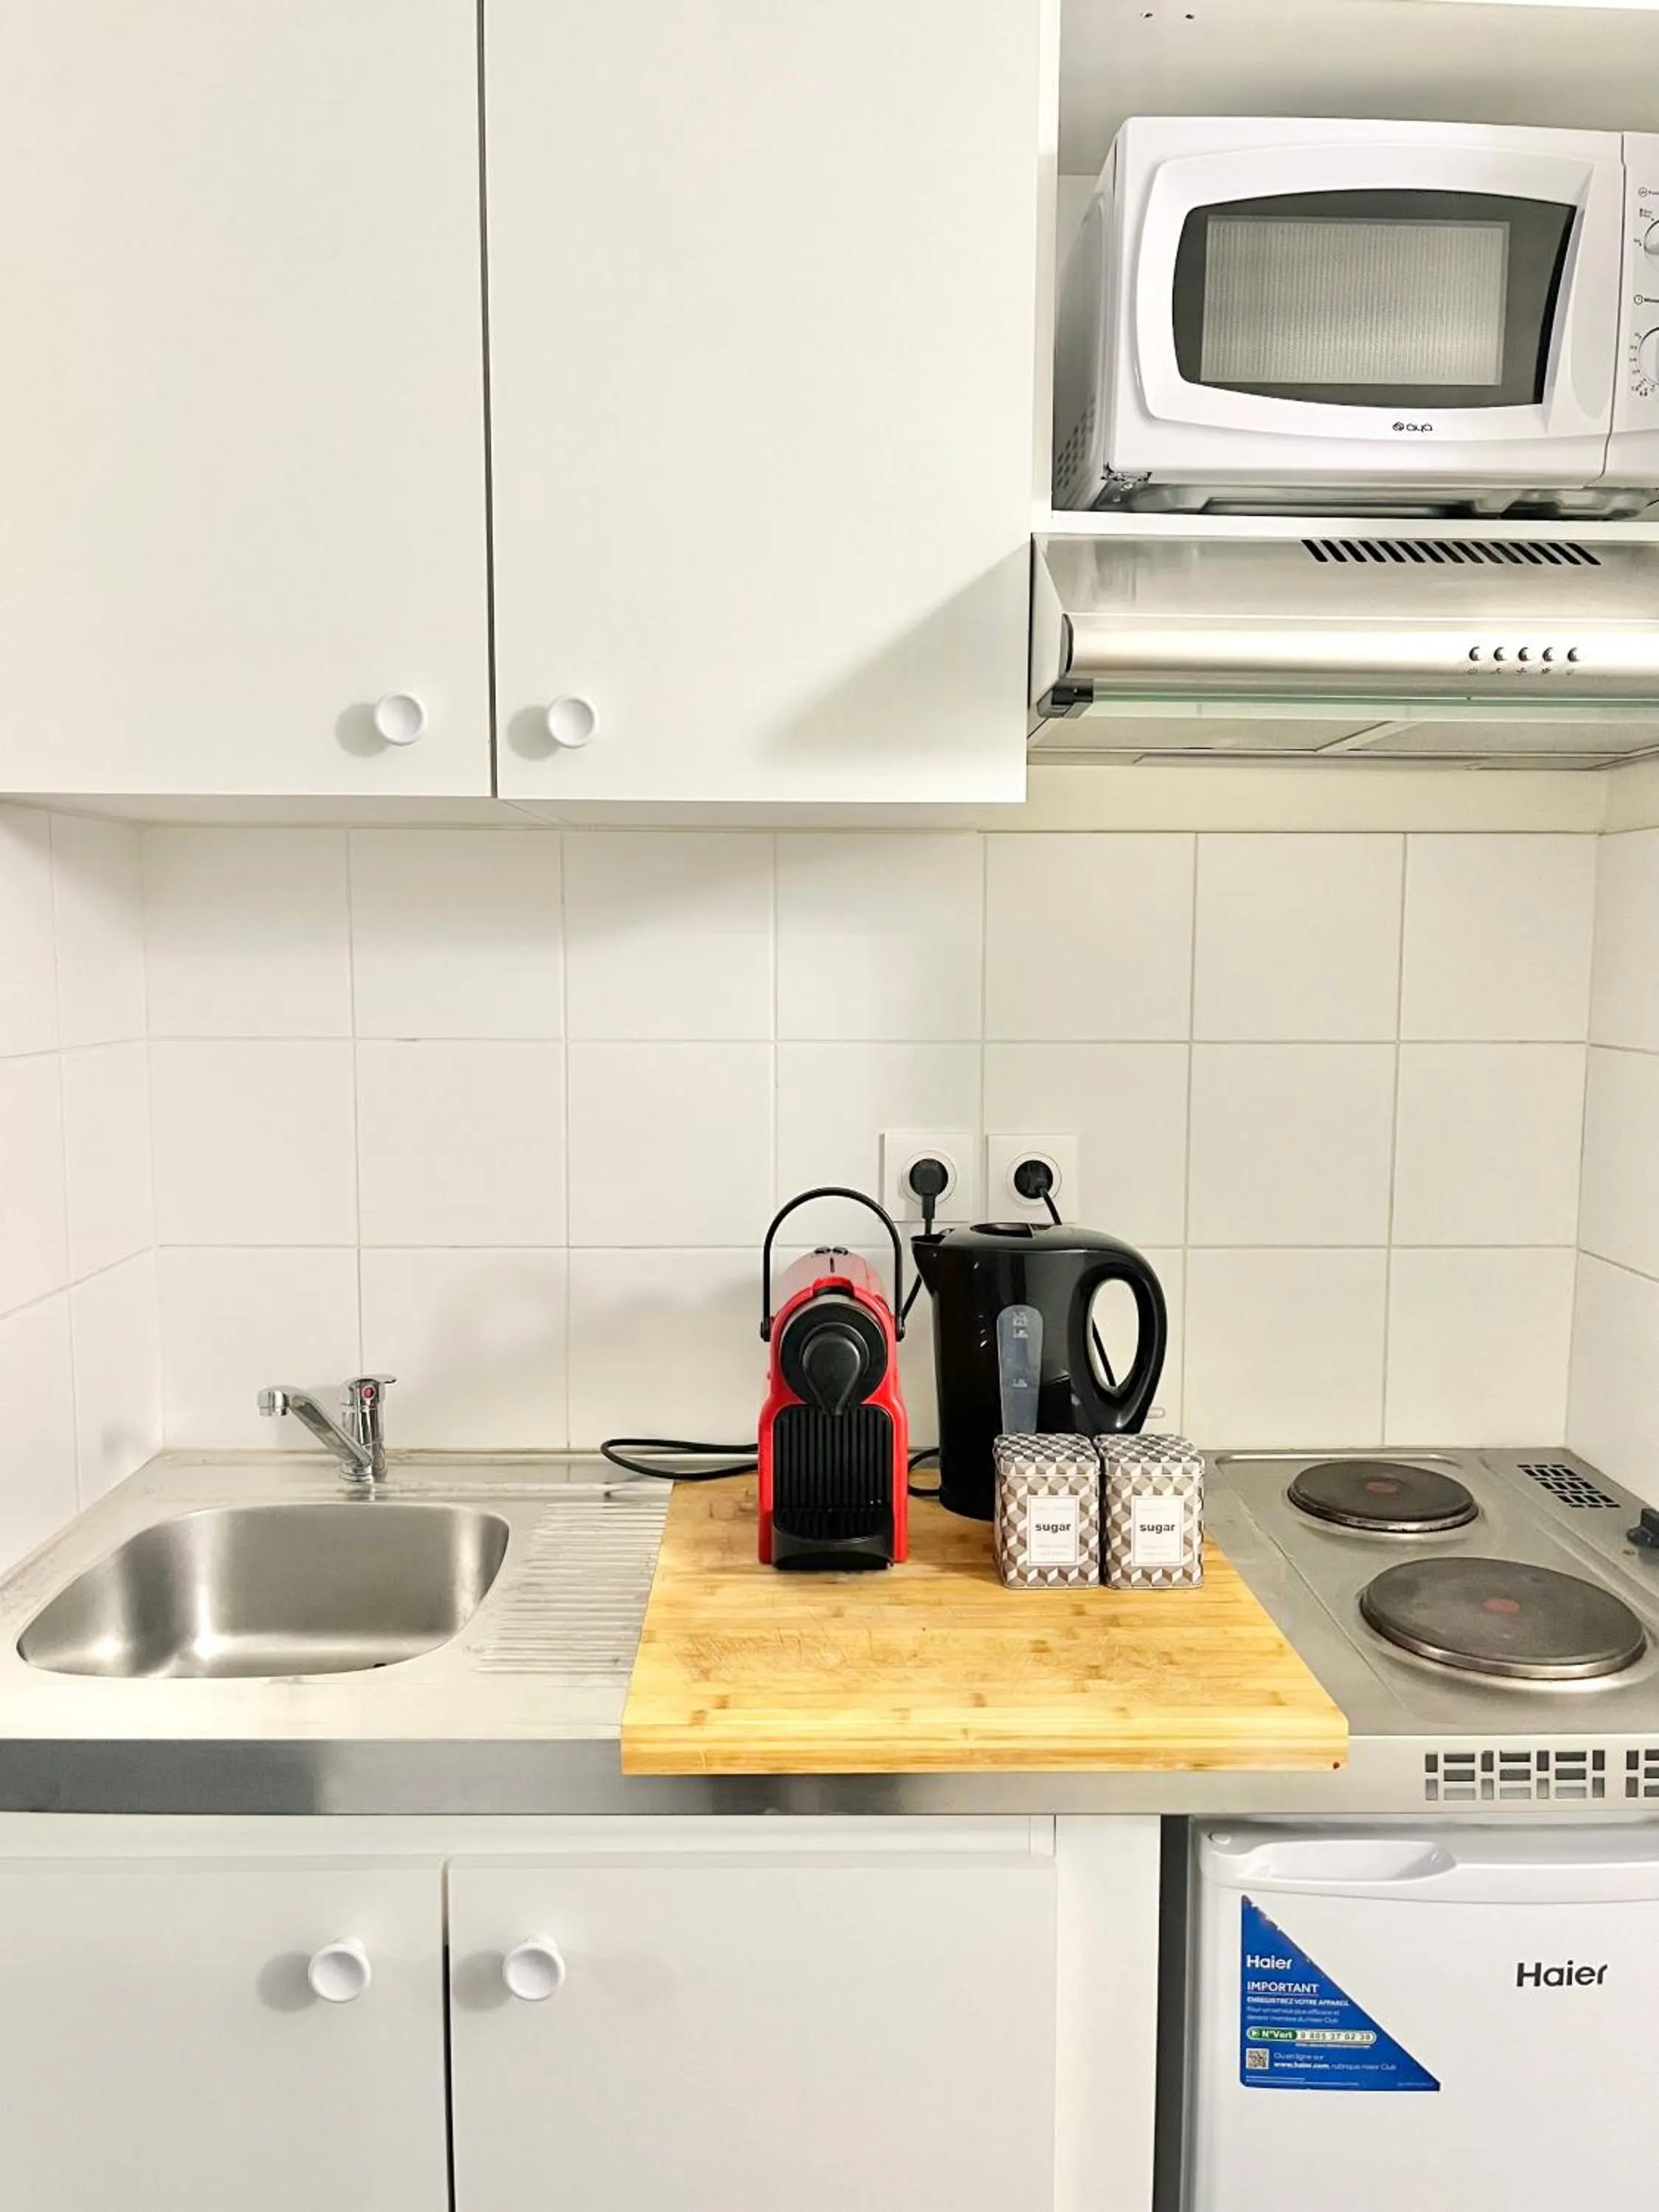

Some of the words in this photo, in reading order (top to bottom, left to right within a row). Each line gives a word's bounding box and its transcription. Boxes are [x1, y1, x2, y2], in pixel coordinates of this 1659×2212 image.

[1406, 422, 1433, 433] aya
[1034, 1523, 1071, 1534] sugar
[1139, 1523, 1176, 1534] sugar
[1246, 1955, 1293, 1969] Haier
[1517, 1960, 1608, 1987] Haier
[1247, 1981, 1319, 1994] IMPORTANT
